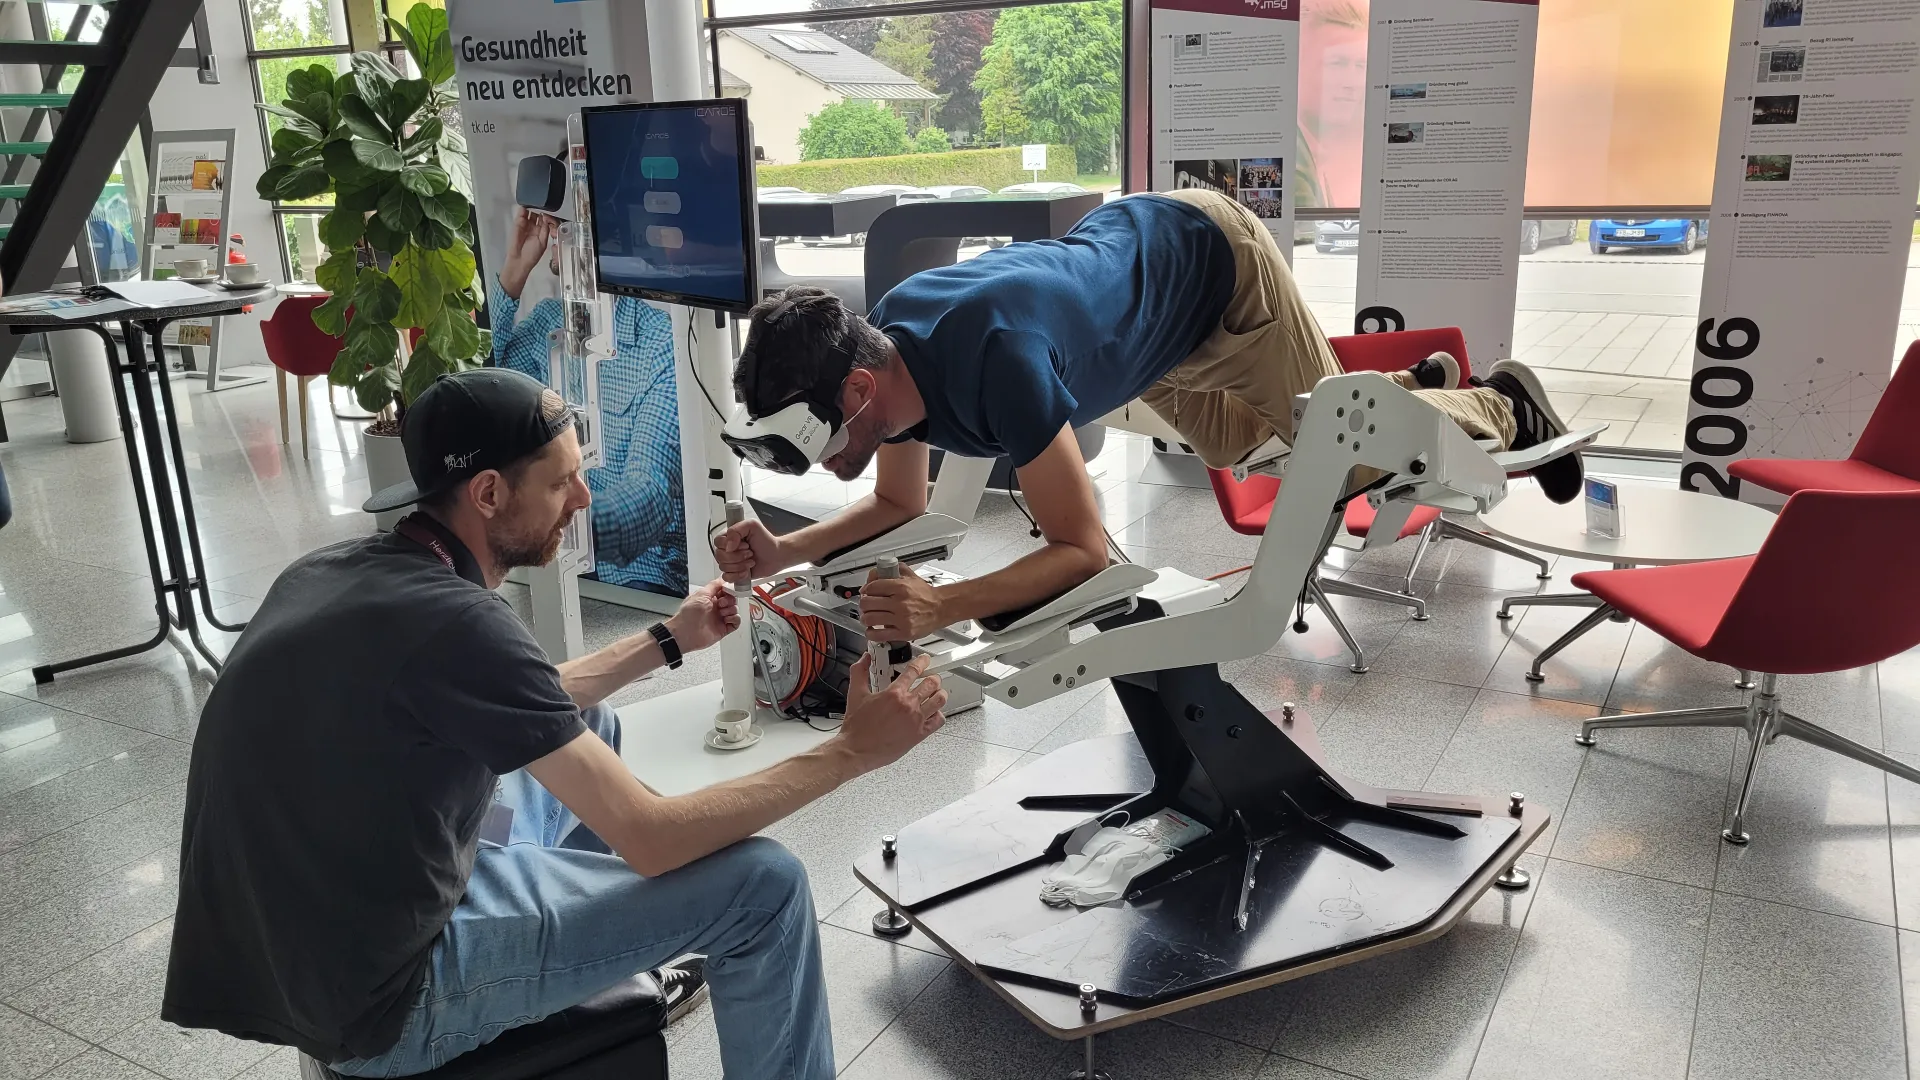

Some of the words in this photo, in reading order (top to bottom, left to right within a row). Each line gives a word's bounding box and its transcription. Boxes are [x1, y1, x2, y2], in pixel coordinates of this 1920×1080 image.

[461, 28, 588, 62] Gesundheit
[466, 79, 505, 101] neu
[512, 67, 632, 99] entdecken
[694, 106, 736, 118] ICAROS
[471, 120, 496, 134] tk.de
[1681, 316, 1761, 500] 2006
[795, 424, 808, 440] Gear
[805, 415, 814, 424] VR
